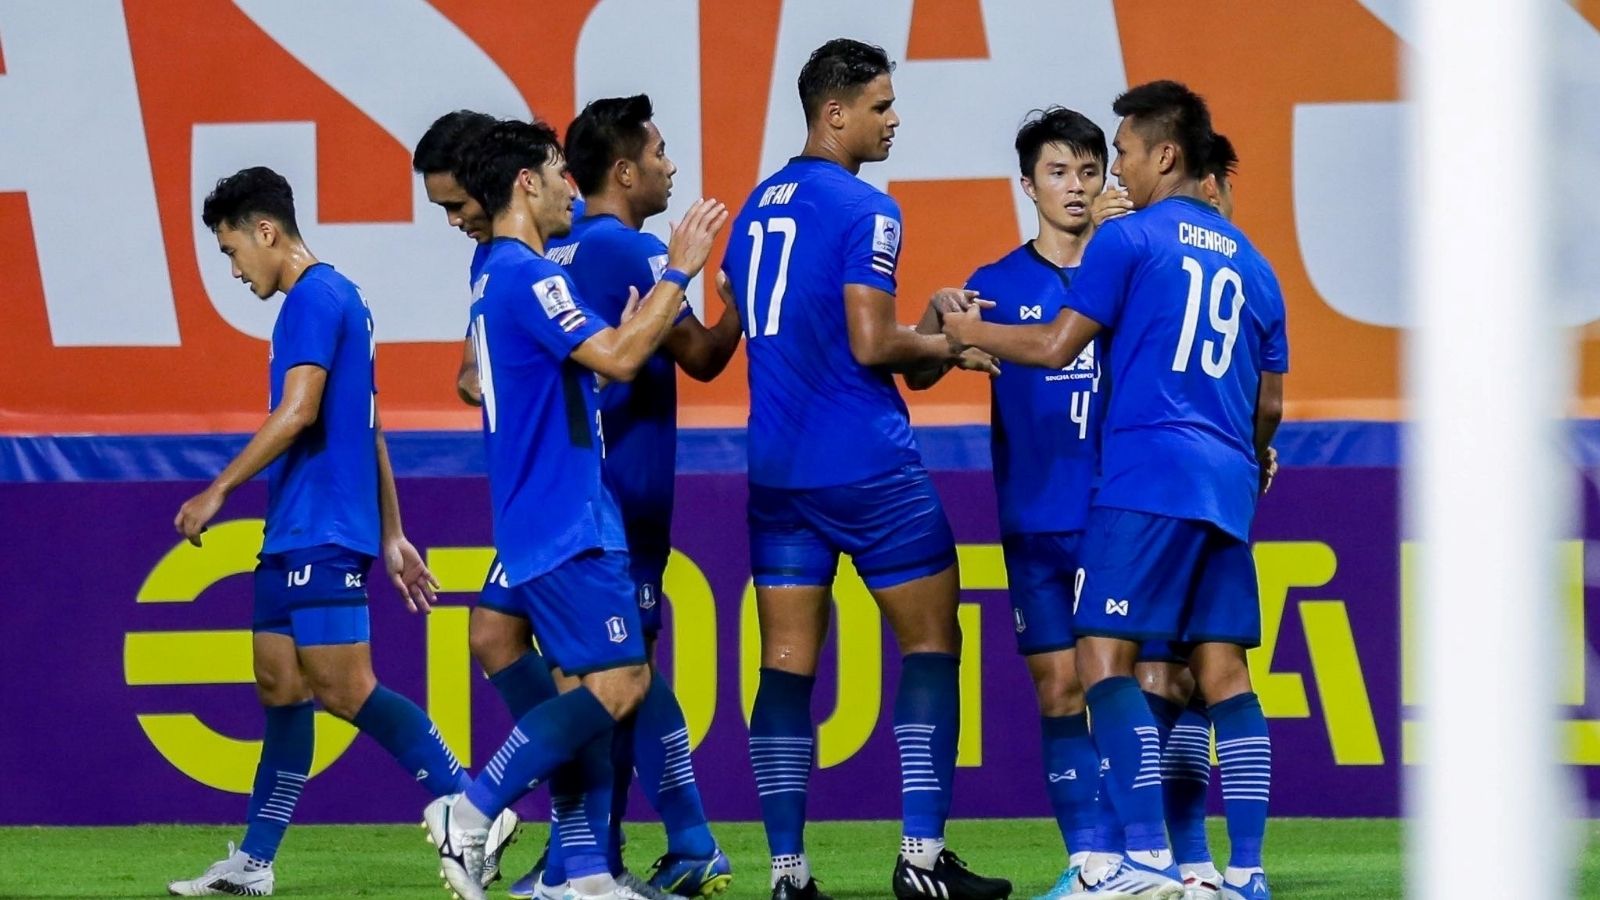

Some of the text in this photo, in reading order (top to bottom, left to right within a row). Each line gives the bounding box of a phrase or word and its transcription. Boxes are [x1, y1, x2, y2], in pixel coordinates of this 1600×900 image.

[1178, 222, 1238, 259] CHENROP
[747, 217, 797, 339] 17
[1171, 256, 1246, 380] 19
[1045, 372, 1094, 382] SINGHA CORPO
[1070, 390, 1090, 440] 4
